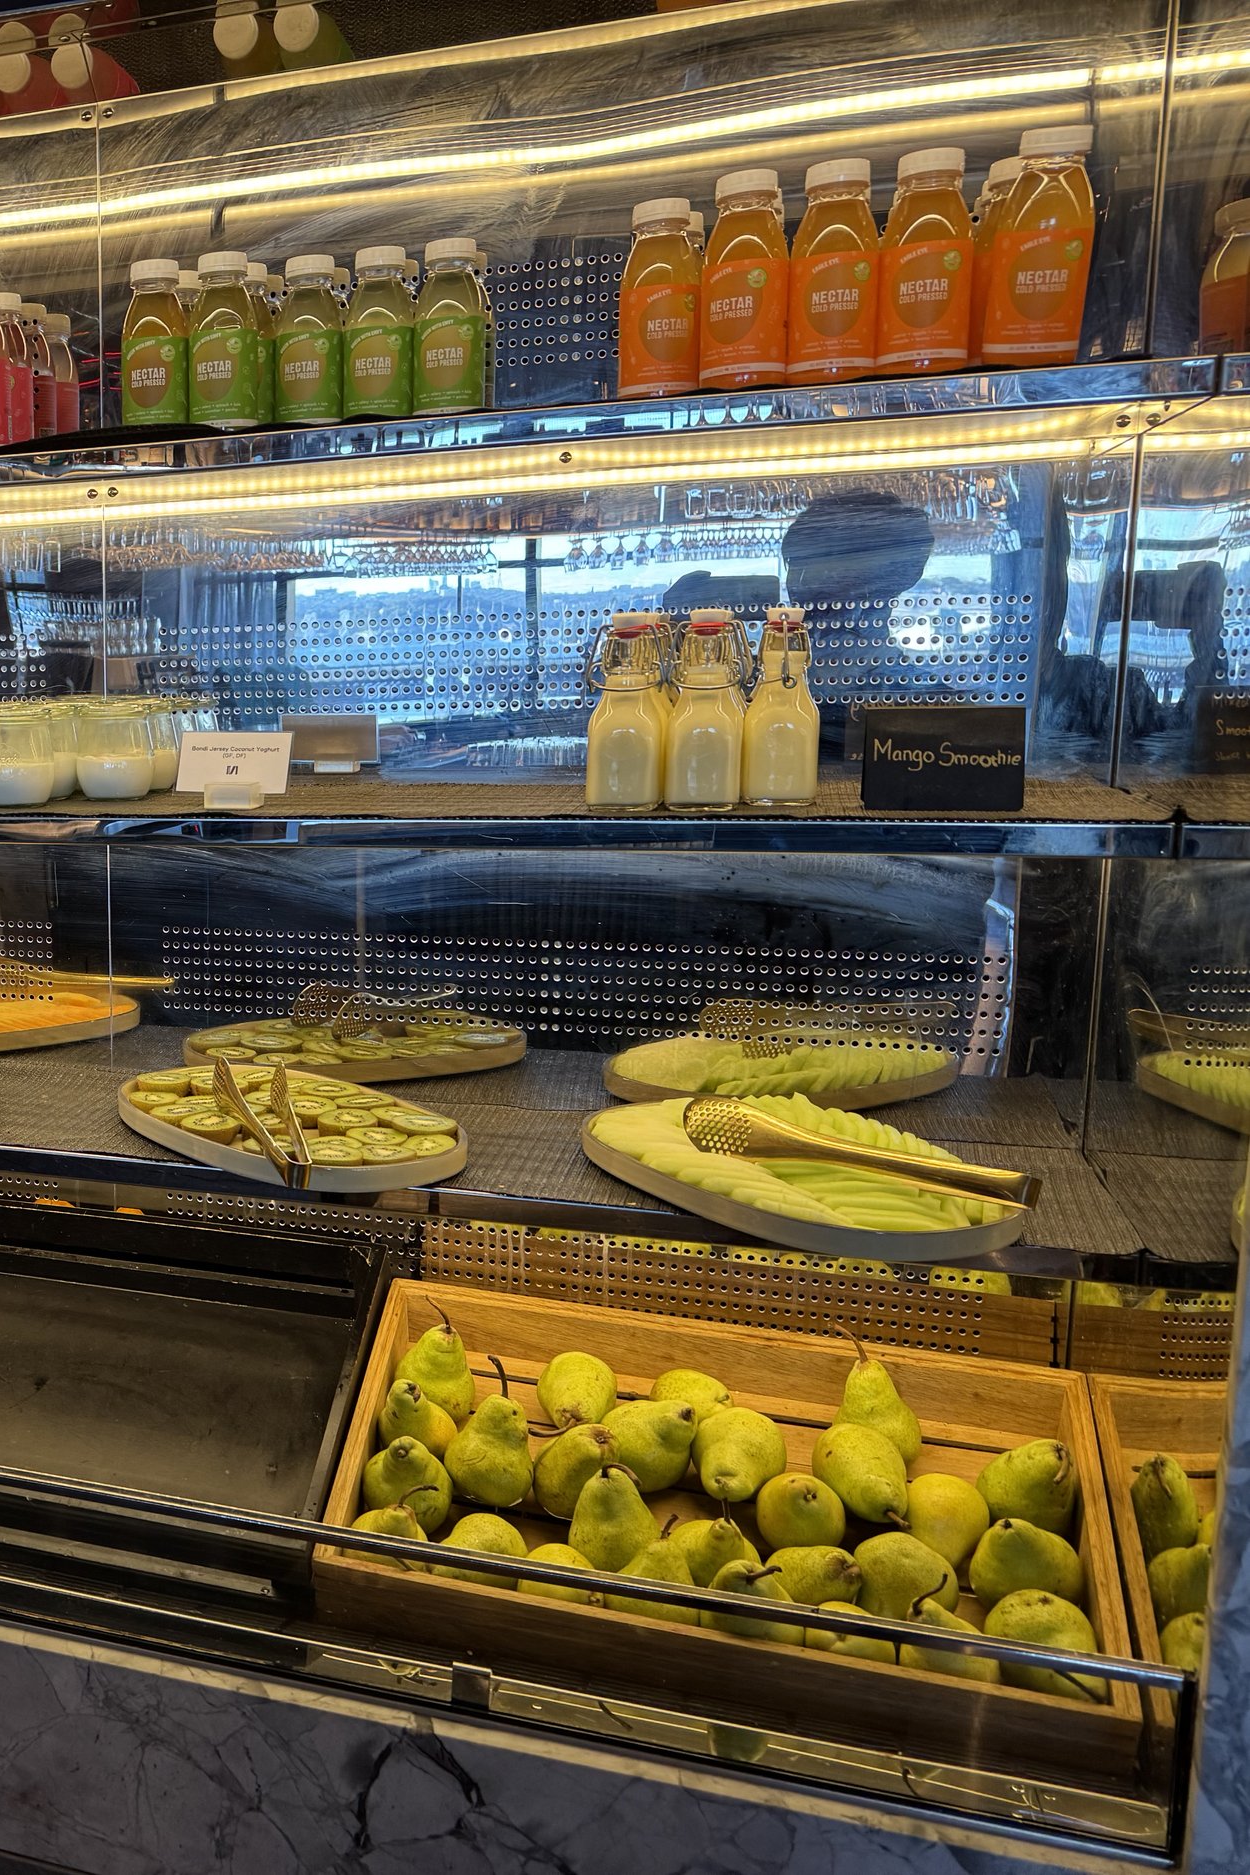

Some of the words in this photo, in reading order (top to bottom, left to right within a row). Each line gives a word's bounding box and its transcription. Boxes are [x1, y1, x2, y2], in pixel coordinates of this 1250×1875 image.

[1016, 269, 1069, 284] NECTAR
[900, 278, 948, 295] NECTAR
[1016, 284, 1034, 294] COLD
[1035, 283, 1067, 292] PRESSED
[812, 288, 859, 304] NECTAR
[899, 294, 915, 304] COLD
[918, 292, 948, 302] PRESSED
[710, 296, 753, 314] NECTAR
[811, 304, 827, 313] COLD
[830, 301, 859, 311] PRESSED
[710, 312, 722, 322] COLD
[724, 308, 753, 319] PRESSED
[647, 318, 688, 332] NECTAR
[426, 347, 463, 360] NECTAR
[197, 360, 231, 374] NECTAR
[284, 360, 319, 374] NECTAR
[355, 356, 391, 369] NECTAR
[426, 360, 438, 368] COLD
[440, 358, 463, 366] PRESSED
[131, 368, 166, 381] NECTAR
[208, 372, 231, 380] PRESSED
[296, 371, 319, 380] PRESSED
[355, 369, 366, 377] COLD
[368, 367, 391, 375] PRESSED
[143, 378, 166, 386] PRESSED
[873, 738, 935, 772] Mango
[938, 742, 1022, 767] Smoothie
